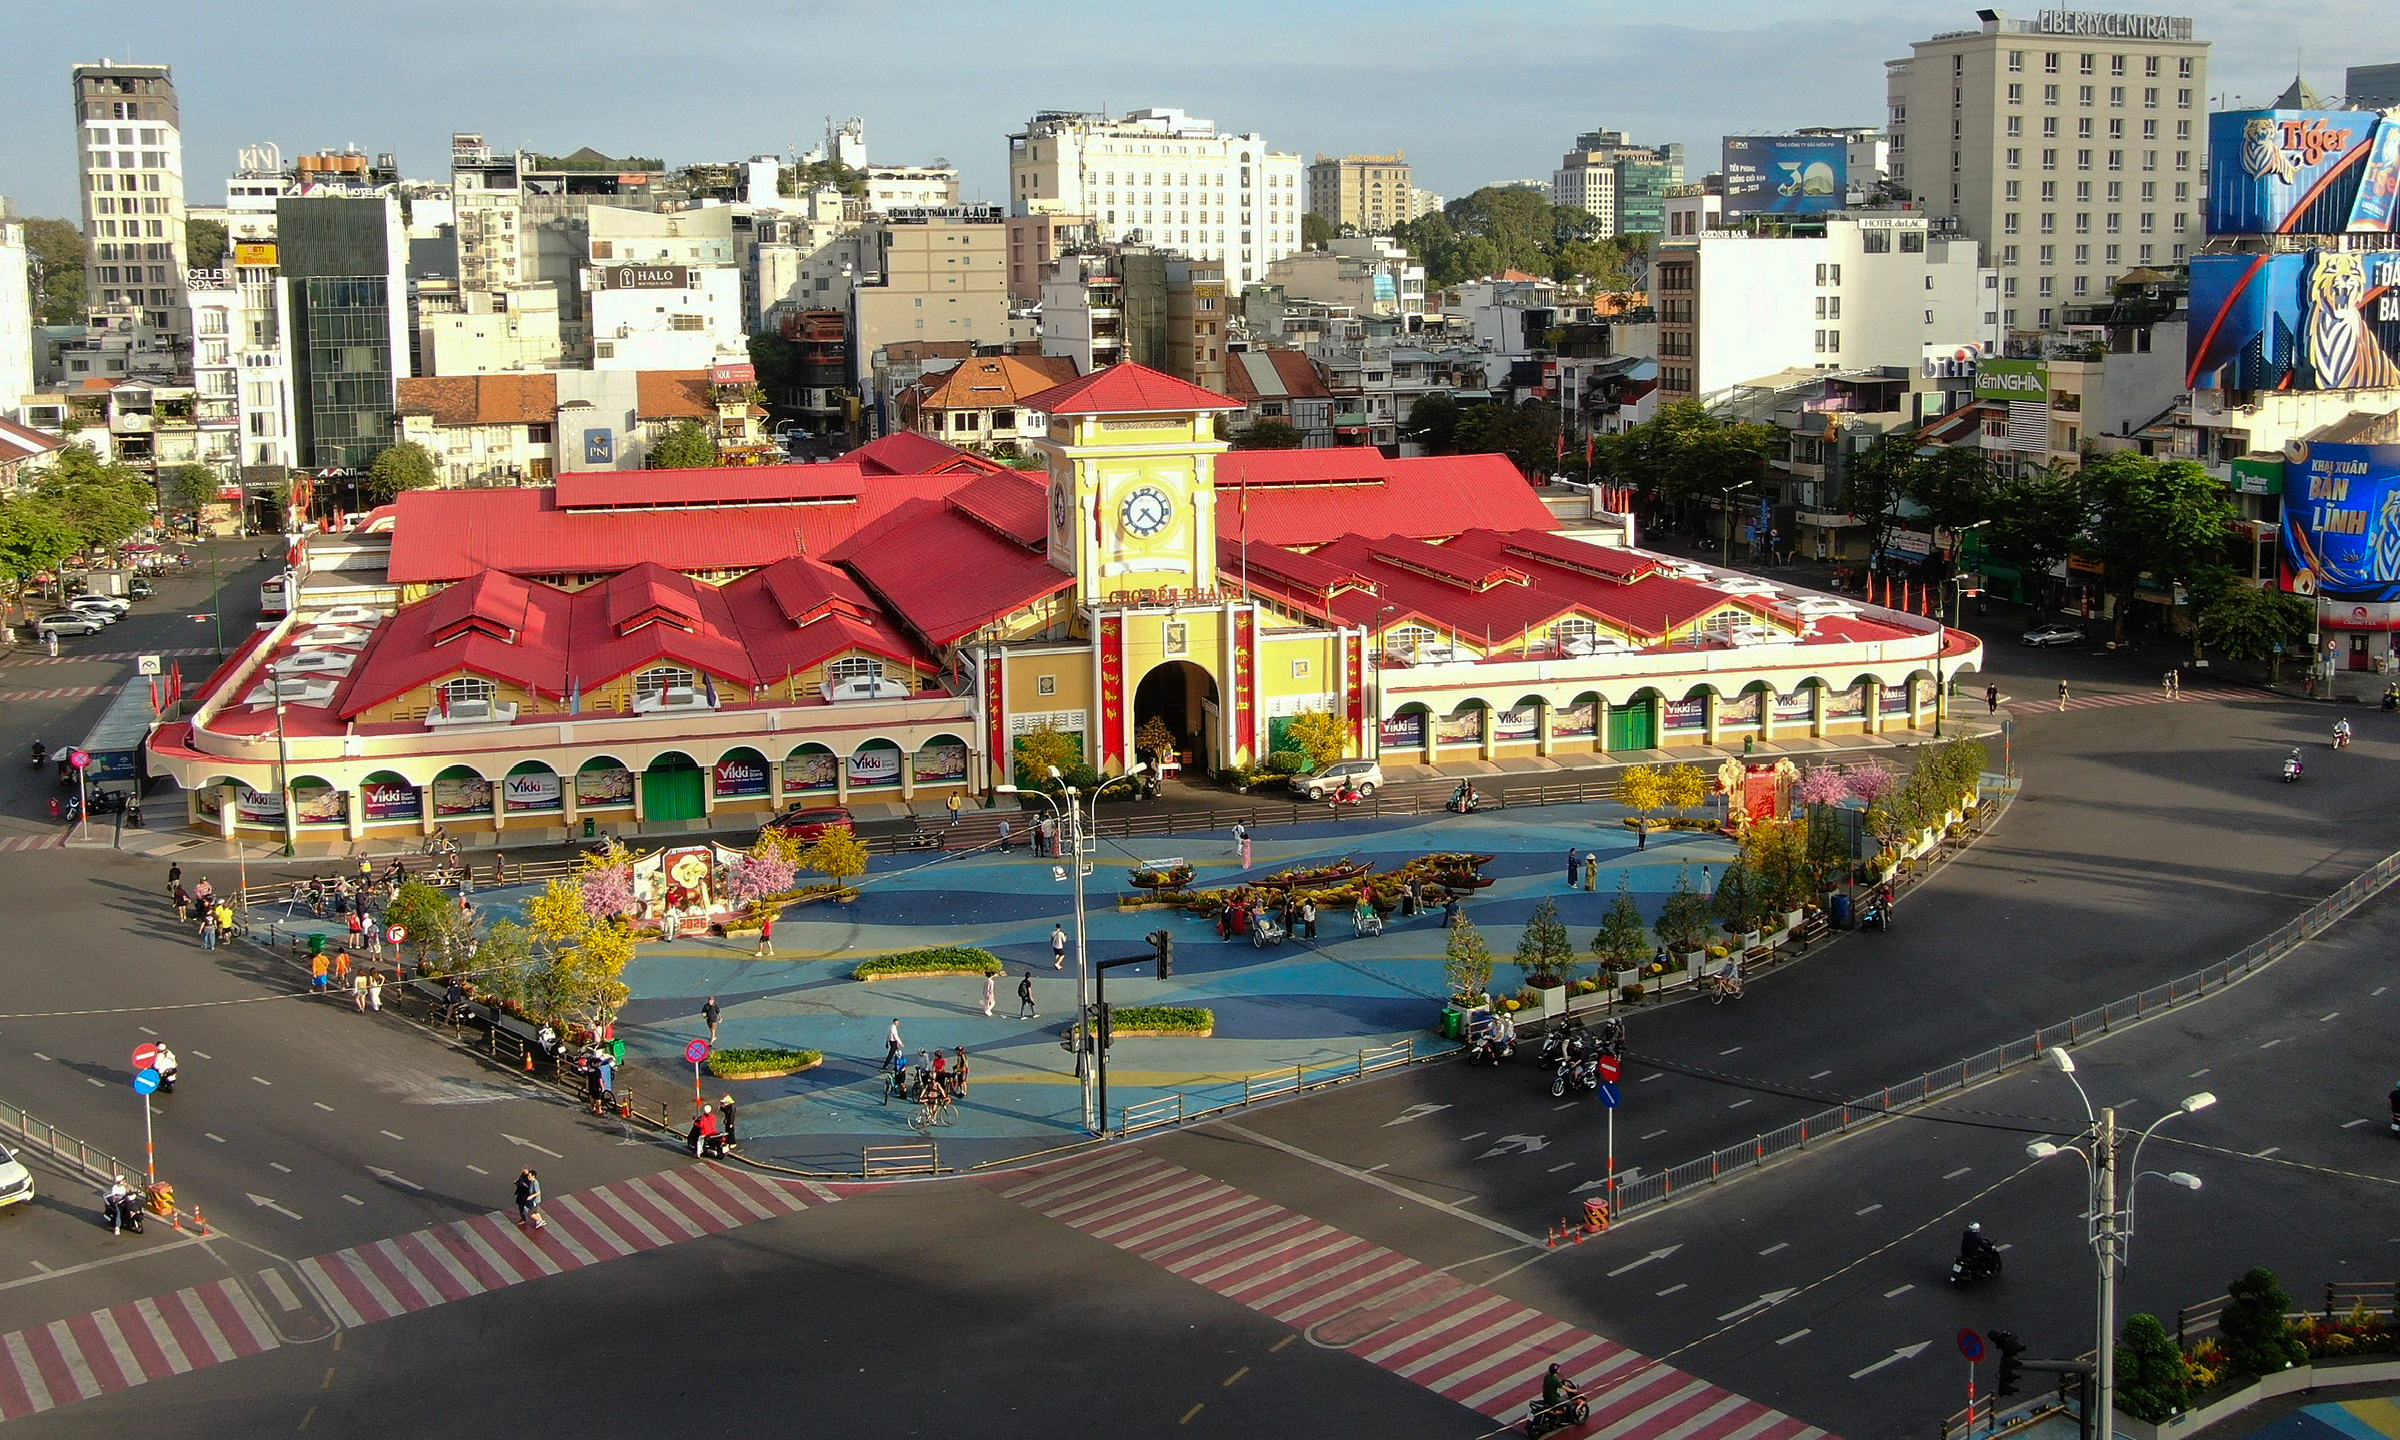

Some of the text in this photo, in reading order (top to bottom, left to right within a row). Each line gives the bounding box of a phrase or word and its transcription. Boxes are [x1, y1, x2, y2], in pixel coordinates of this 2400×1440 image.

[2280, 119, 2352, 166] Tiger
[1699, 230, 1749, 239] OZONE BAR
[188, 268, 232, 279] CELEB
[638, 270, 674, 281] HALO
[188, 280, 213, 290] SPA
[590, 446, 609, 458] PNJ
[851, 753, 881, 770] Vikki
[718, 761, 749, 779] Vikki
[508, 776, 541, 793] Vikki
[242, 790, 268, 805] Vikki
[366, 785, 400, 803] Vikki
